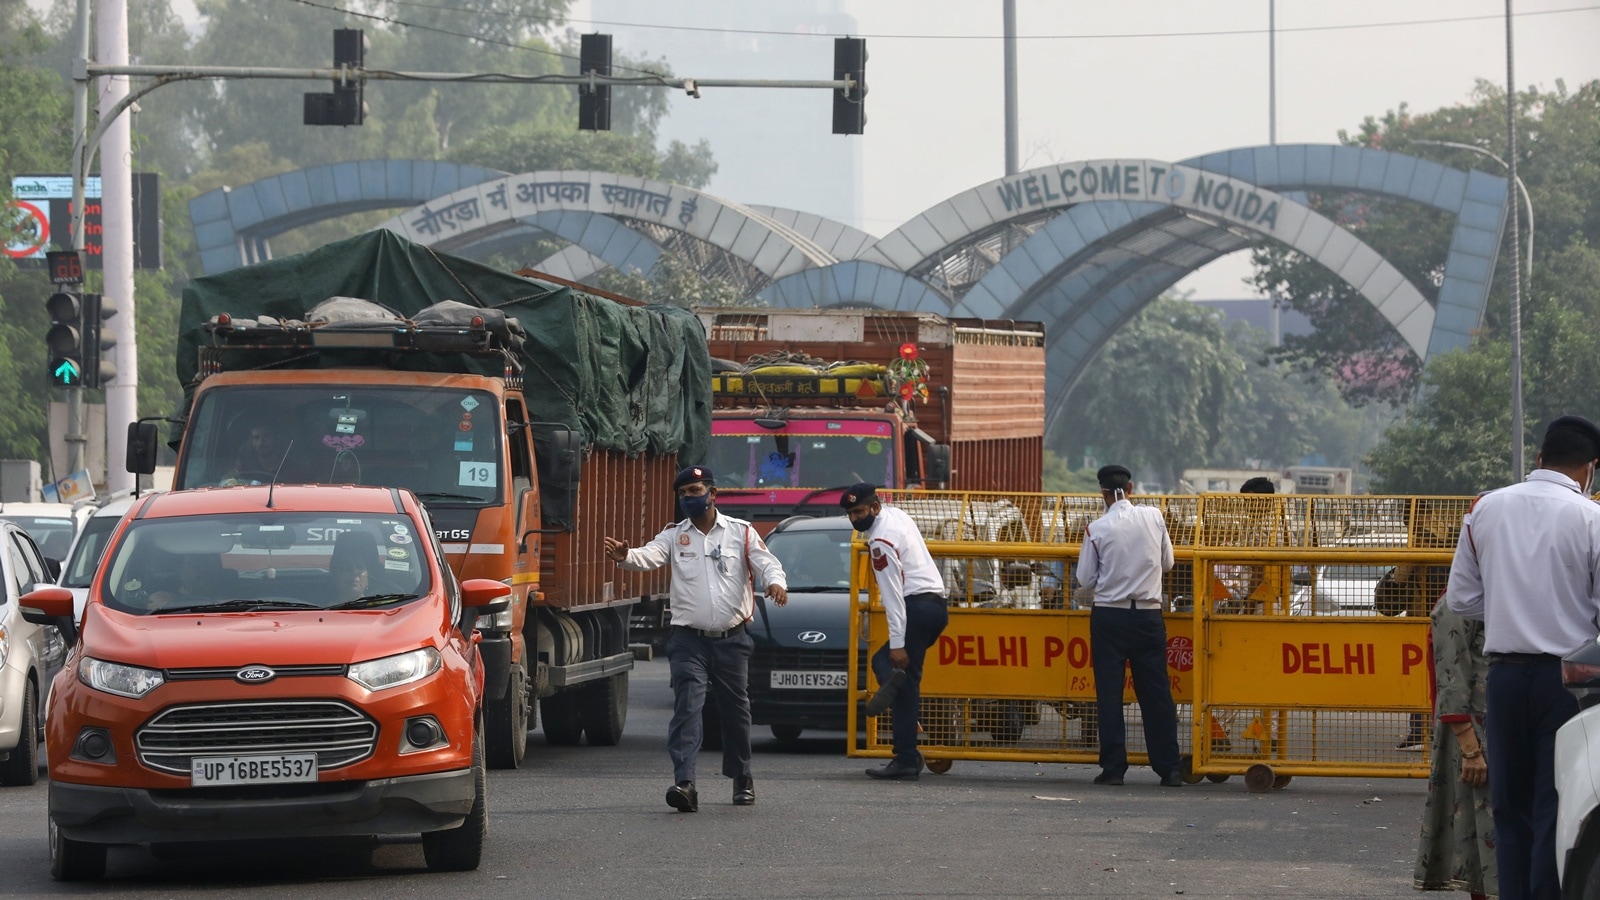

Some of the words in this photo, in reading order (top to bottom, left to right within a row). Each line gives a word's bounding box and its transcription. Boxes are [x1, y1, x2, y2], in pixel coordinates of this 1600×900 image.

[997, 165, 1140, 212] WELCOME
[1150, 166, 1186, 199] TO
[1192, 174, 1280, 231] NOIDA
[411, 196, 481, 237] नौएडा
[487, 184, 508, 210] में
[516, 182, 590, 205] आपका
[601, 184, 672, 216] स्वागत
[678, 193, 699, 226] है
[468, 467, 489, 482] 19
[451, 529, 470, 539] GS
[938, 635, 1029, 668] DELHI
[1172, 638, 1188, 648] ED
[1282, 642, 1375, 675] DELHI
[245, 670, 264, 679] Ford
[778, 673, 847, 687] JH01EV5245
[204, 759, 314, 780] UP16BE5537
